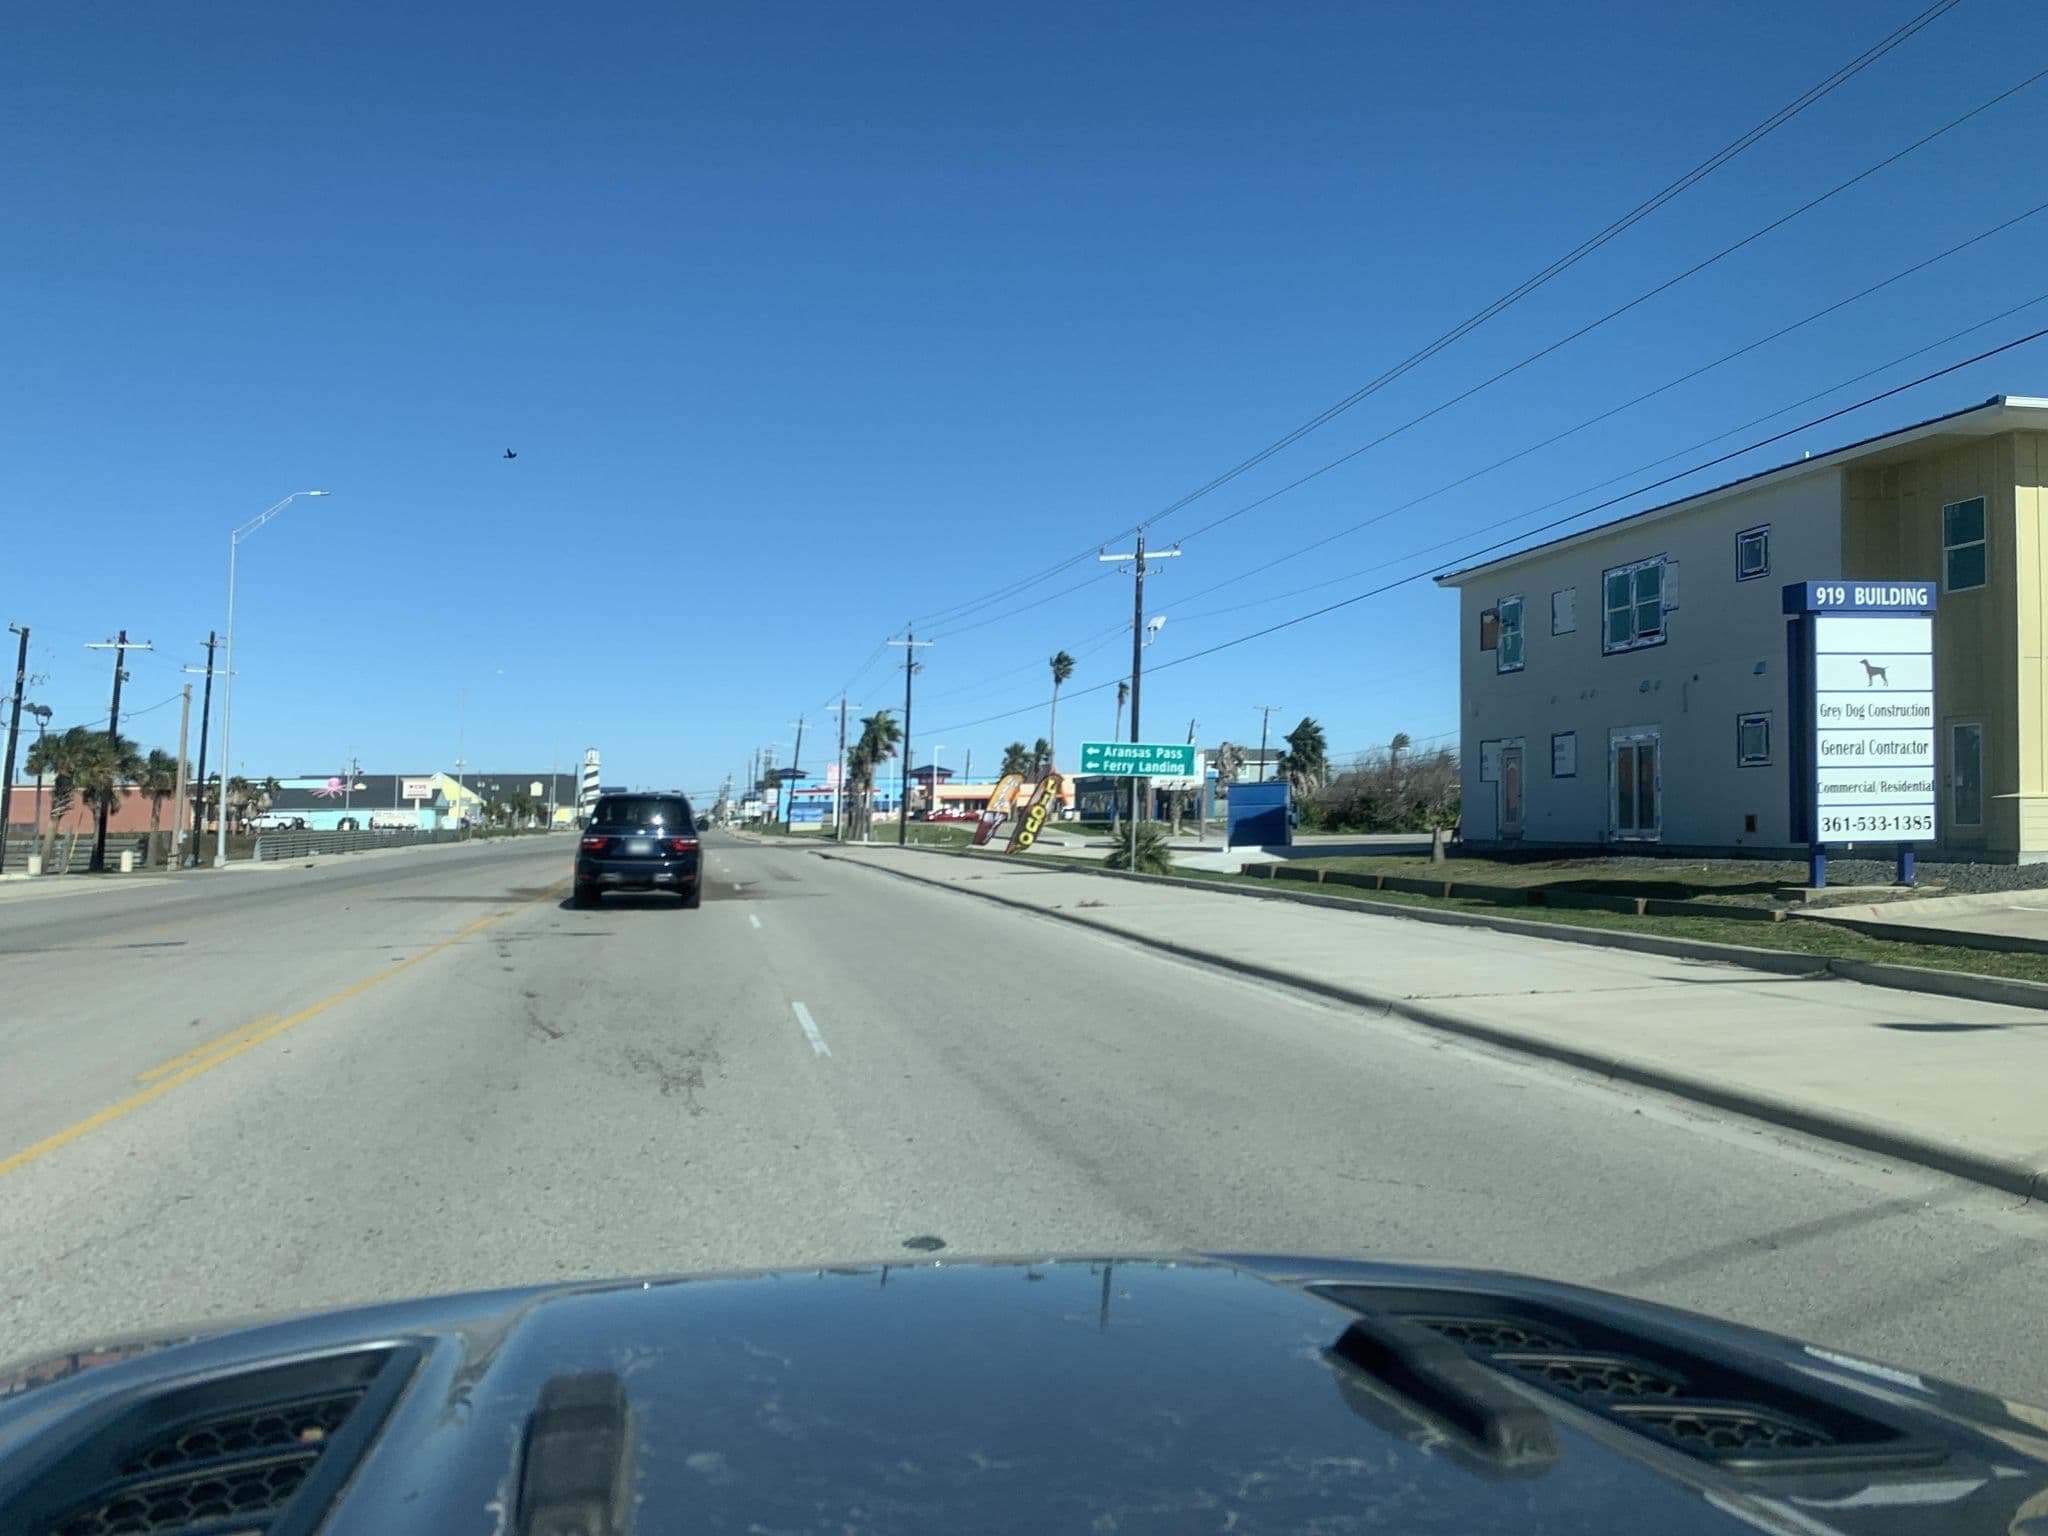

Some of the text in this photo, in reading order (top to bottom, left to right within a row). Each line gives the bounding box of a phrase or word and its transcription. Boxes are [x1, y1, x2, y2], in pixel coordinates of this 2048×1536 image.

[1816, 587, 1928, 606] 919 BUILDING
[1820, 703, 1930, 720] Grey Dog Construction
[1104, 746, 1183, 759] Aransas Pass
[1821, 739, 1929, 756] General Contractor
[1103, 761, 1185, 775] Ferry Landing
[1015, 777, 1057, 850] LIQUO
[1822, 816, 1932, 832] 361-533-1385
